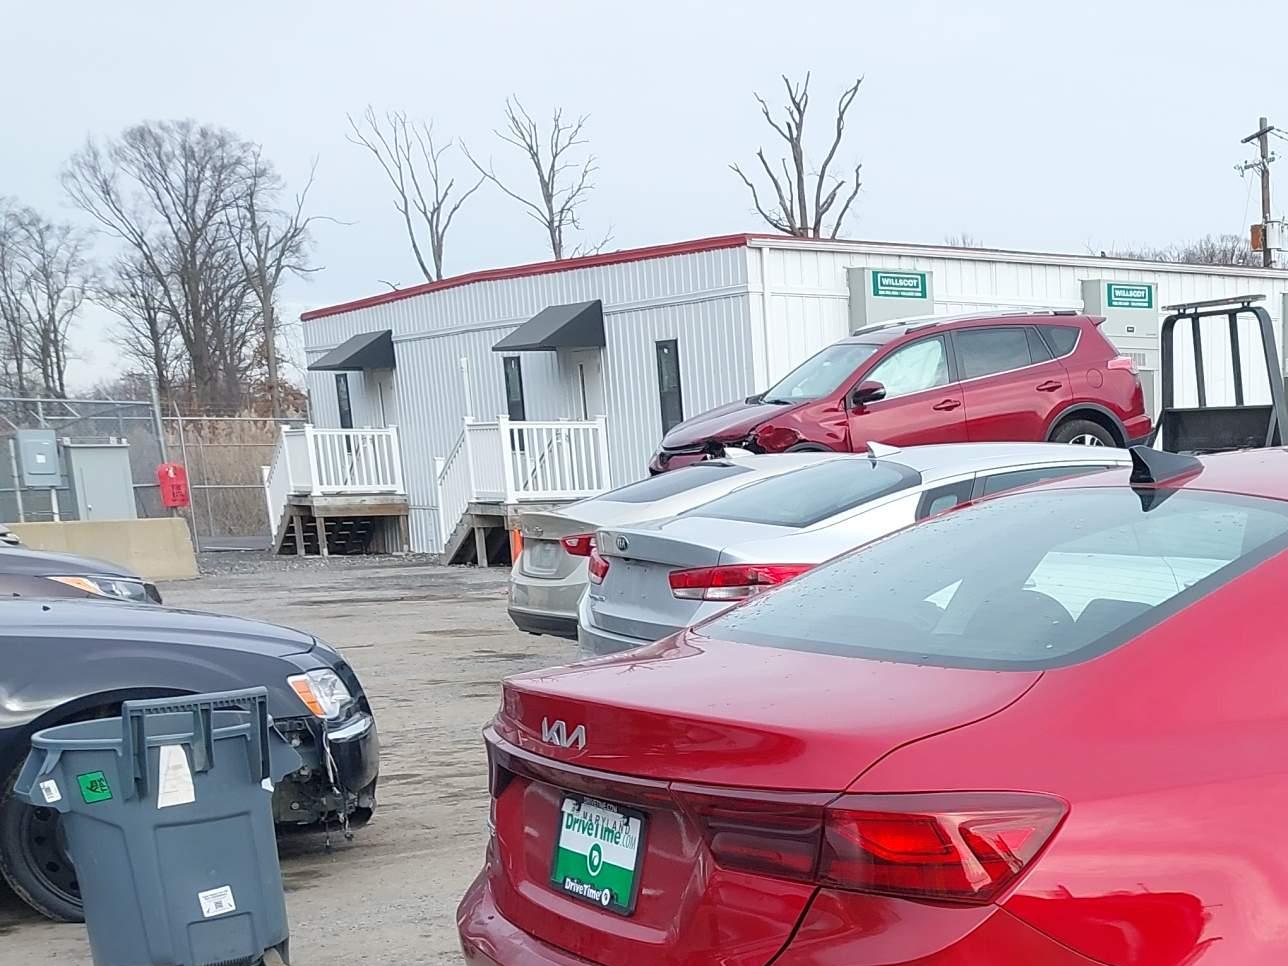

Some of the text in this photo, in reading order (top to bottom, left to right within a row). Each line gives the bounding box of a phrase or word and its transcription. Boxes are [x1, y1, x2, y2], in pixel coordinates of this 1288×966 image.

[881, 277, 918, 287] WILLSCOT
[1114, 289, 1146, 298] WILLSCOT
[542, 716, 586, 751] KIA
[565, 878, 601, 901] DriveTime
